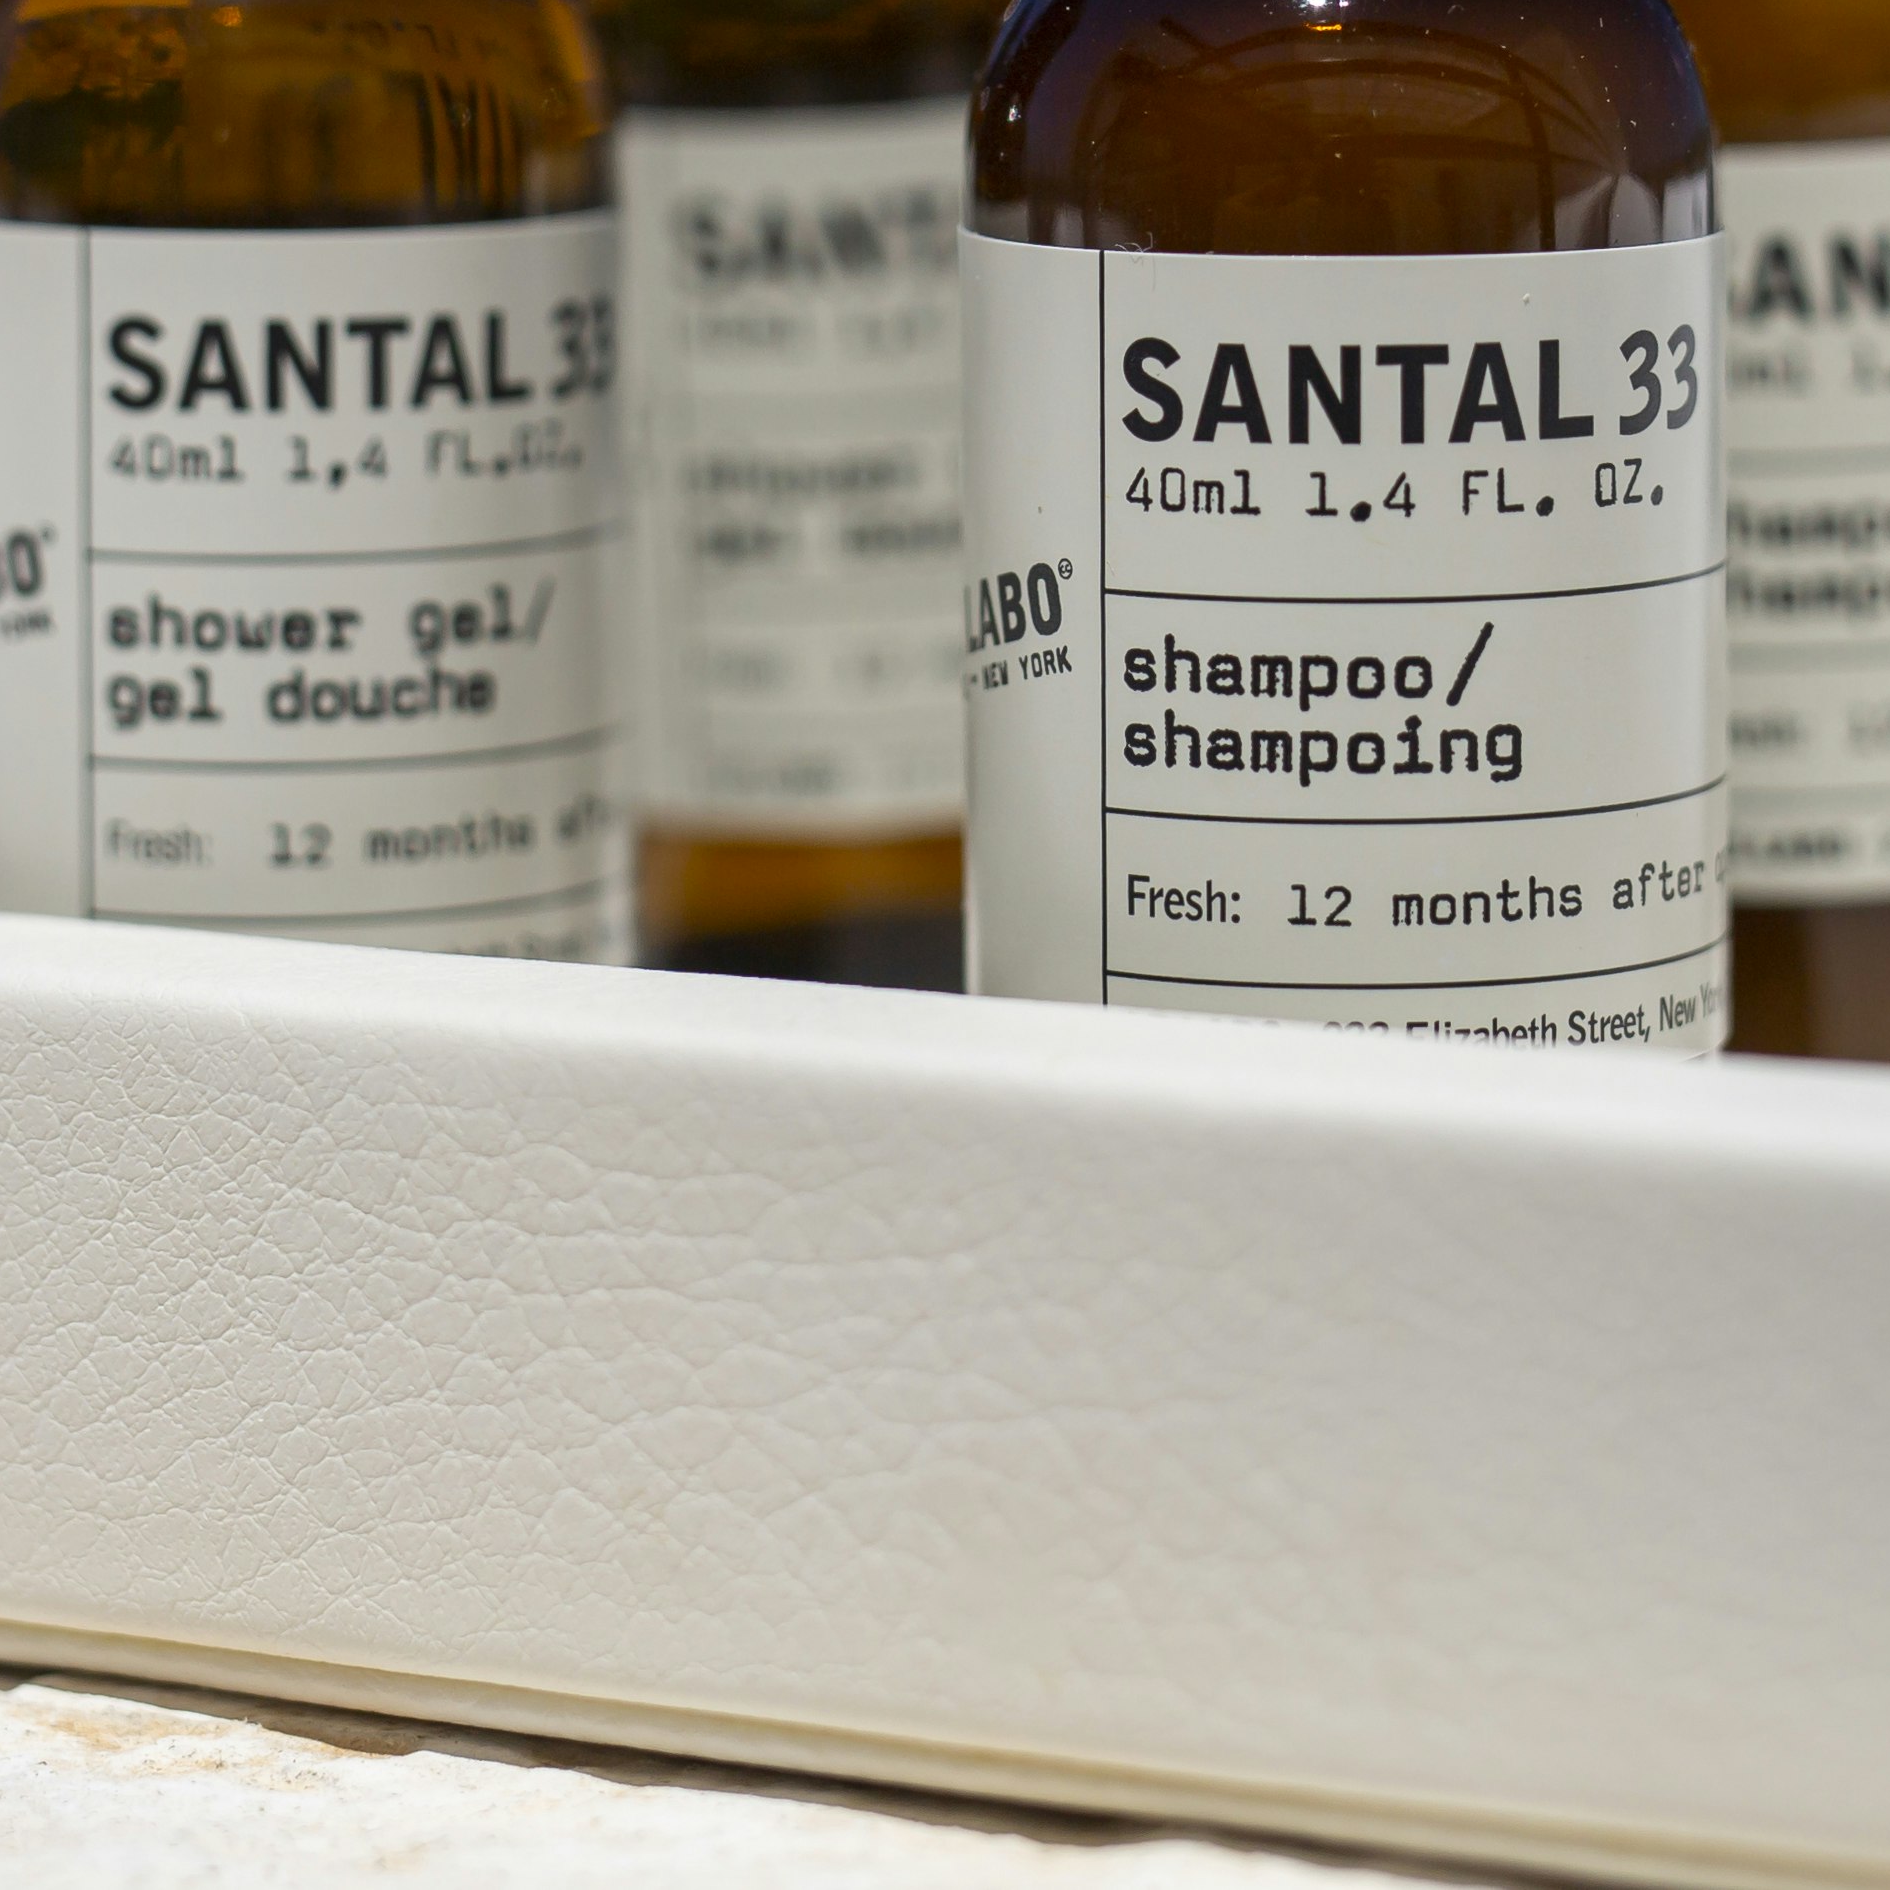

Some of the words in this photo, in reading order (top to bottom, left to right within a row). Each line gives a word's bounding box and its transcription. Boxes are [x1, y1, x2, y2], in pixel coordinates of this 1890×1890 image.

[106, 314, 532, 412] SANTAL
[1121, 335, 1595, 446] SANTAL
[1618, 322, 1700, 438] 33
[110, 435, 244, 484] 40ml
[1124, 465, 1262, 517] 40ml
[1306, 467, 1417, 522] 1.4
[1462, 466, 1556, 518] FL.
[1594, 456, 1665, 510] OZ.
[108, 594, 362, 654] shower
[410, 576, 557, 660] gel/
[108, 669, 223, 730] gel
[265, 666, 498, 726] douche
[982, 659, 1009, 690] NEW
[1018, 644, 1073, 681] YORK
[1122, 621, 1496, 712] shampoo/
[1122, 708, 1524, 788] shampoing
[107, 817, 214, 866] Fresh:
[270, 823, 332, 869] 12
[365, 813, 535, 864] months
[1126, 873, 1242, 925] Fresh:
[1288, 882, 1353, 929] 12
[1392, 874, 1584, 928] months
[1612, 860, 1705, 911] after
[1567, 1003, 1652, 1046] Street,
[1659, 992, 1697, 1034] New
